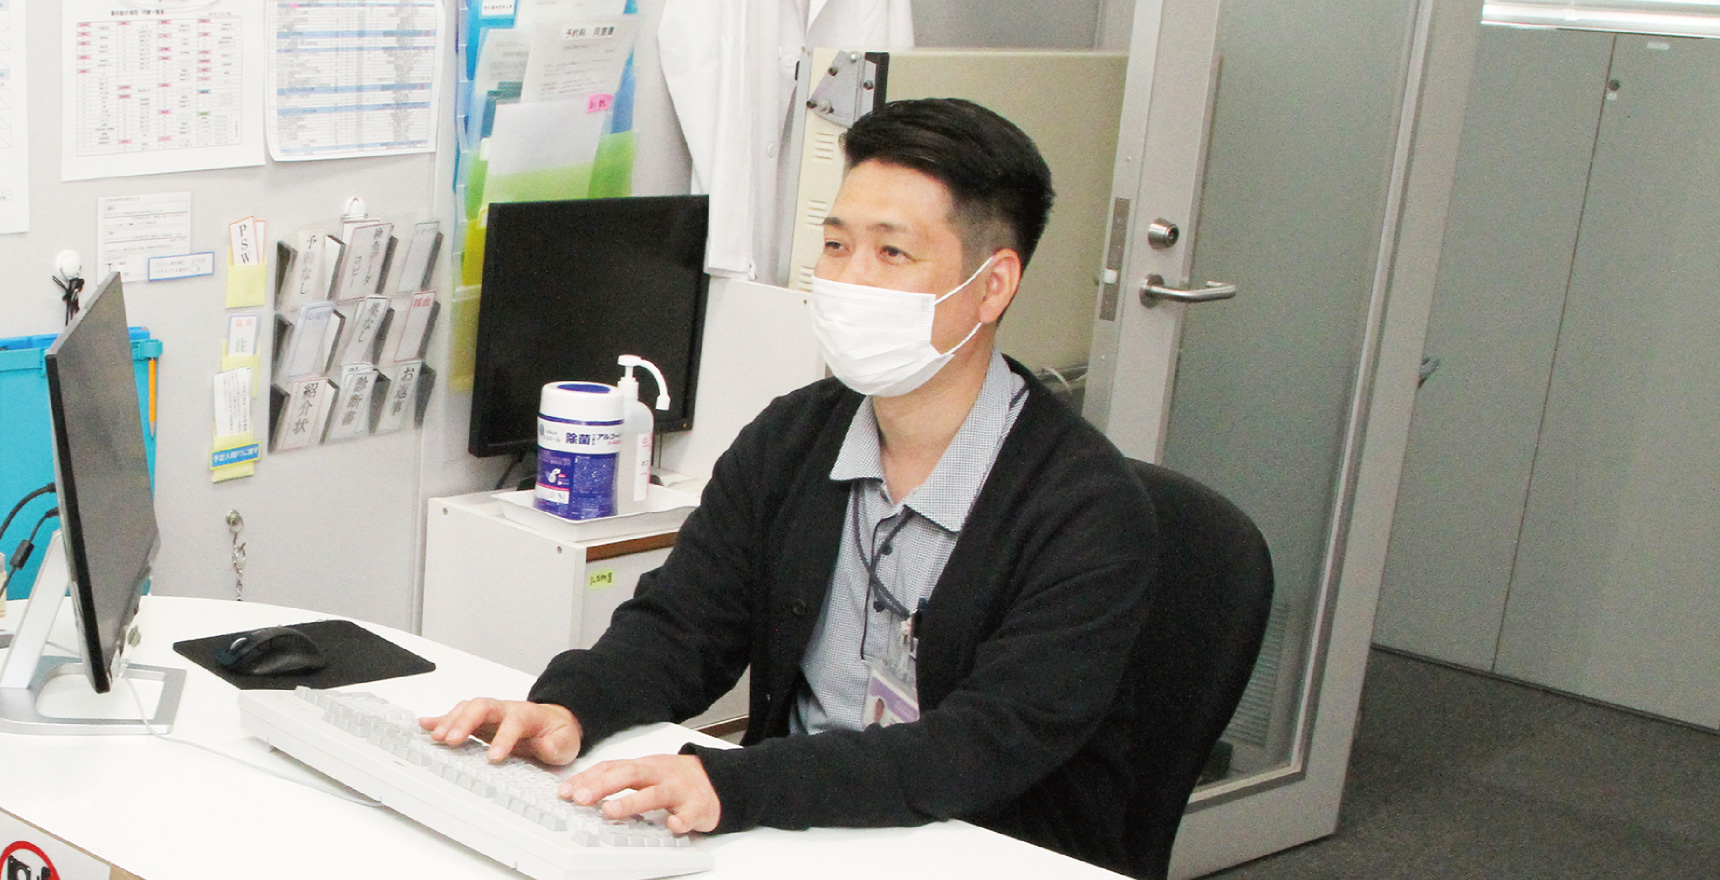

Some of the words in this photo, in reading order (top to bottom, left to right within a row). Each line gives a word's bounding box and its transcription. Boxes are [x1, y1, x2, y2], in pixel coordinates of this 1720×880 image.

[238, 224, 250, 264] PSW
[293, 382, 319, 435] 紹介状
[342, 376, 369, 426] 診断書
[393, 367, 415, 417] お返事
[566, 432, 591, 446] 除菌
